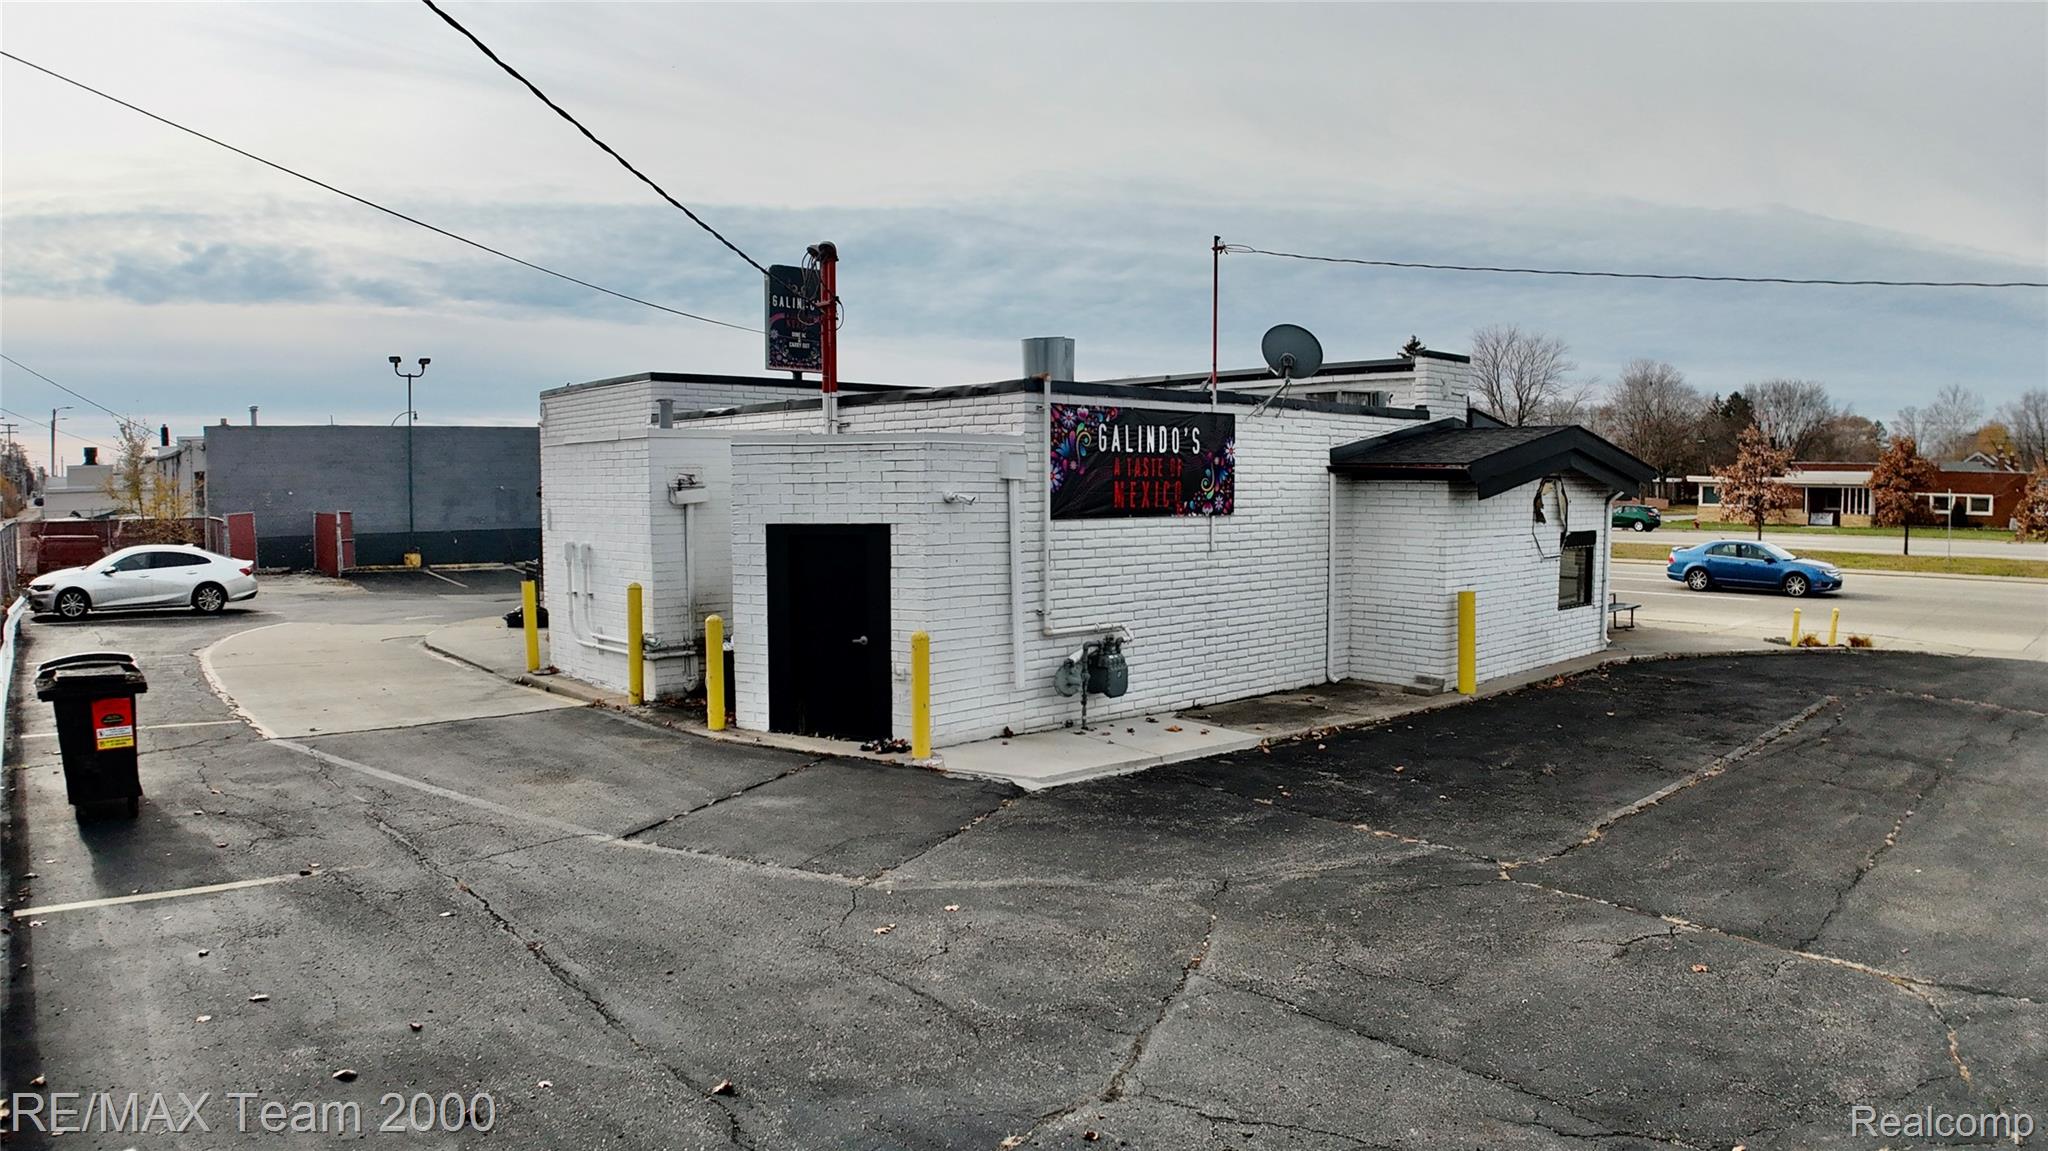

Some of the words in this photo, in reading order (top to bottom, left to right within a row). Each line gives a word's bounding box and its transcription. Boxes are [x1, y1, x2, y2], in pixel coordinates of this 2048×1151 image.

[1098, 423, 1200, 455] GALINDO'S
[1113, 456, 1121, 478] A
[1126, 457, 1163, 478] TASTE
[1169, 457, 1183, 478] OF
[1113, 480, 1183, 509] MEXICO
